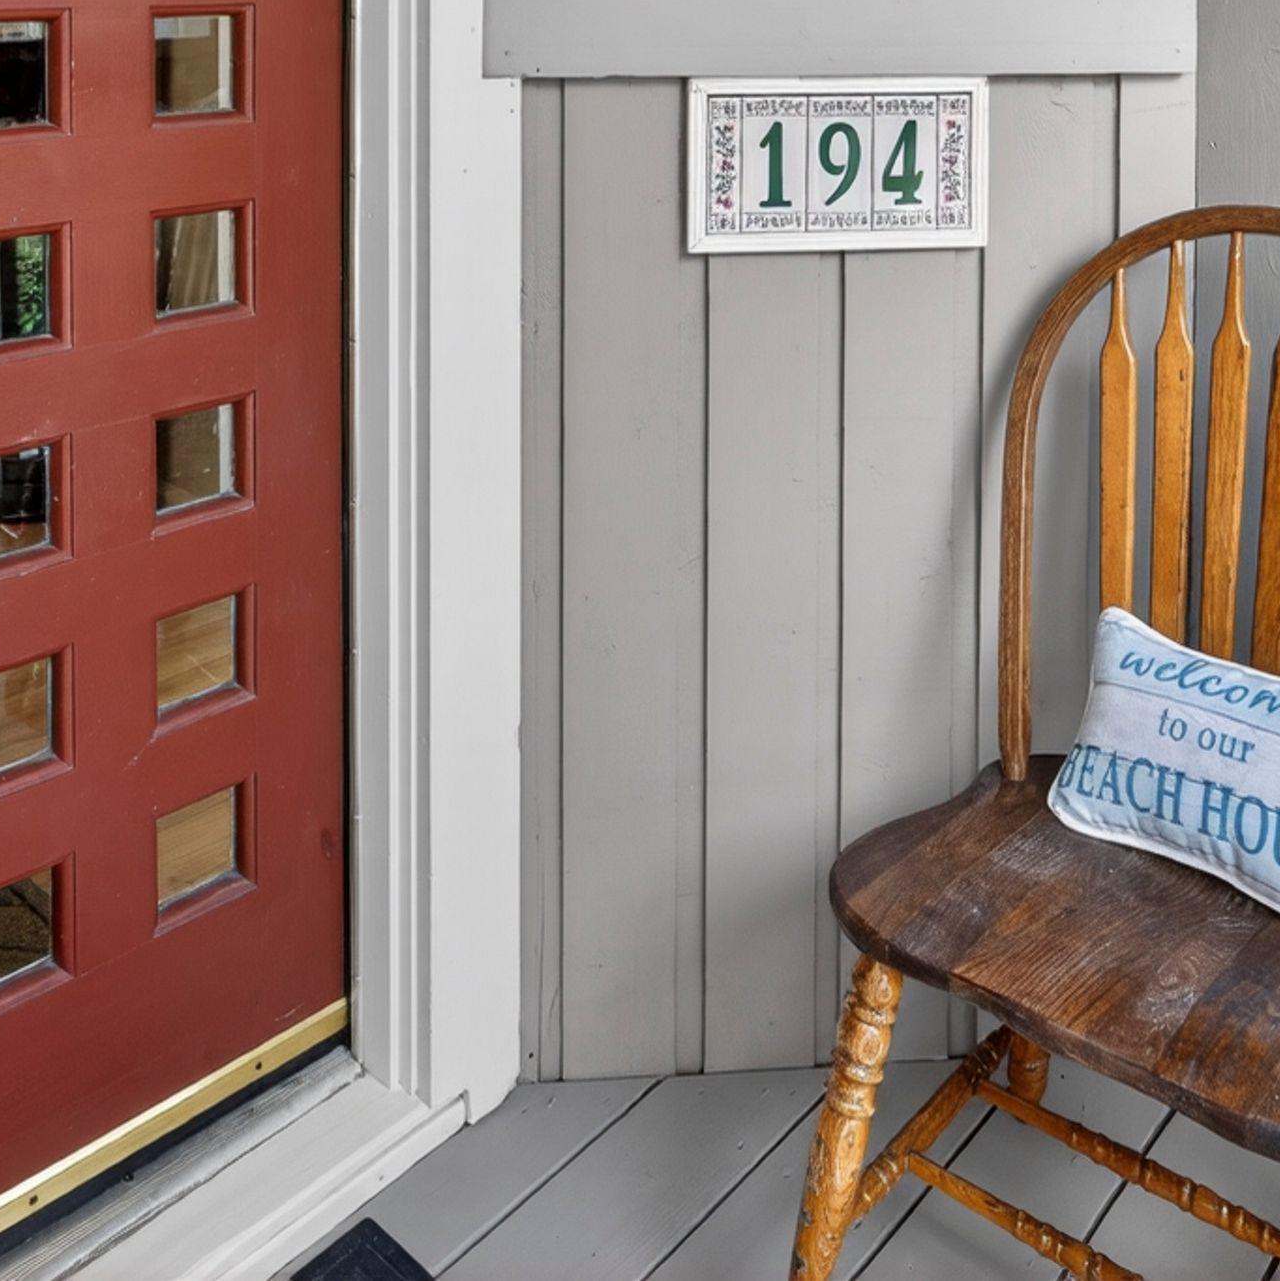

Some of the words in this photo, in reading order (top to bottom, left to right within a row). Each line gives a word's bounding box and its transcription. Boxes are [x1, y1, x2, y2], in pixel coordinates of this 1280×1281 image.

[759, 119, 924, 207] 194
[1158, 708, 1188, 741] to
[1198, 730, 1256, 764] our
[1058, 743, 1184, 826] BEACH
